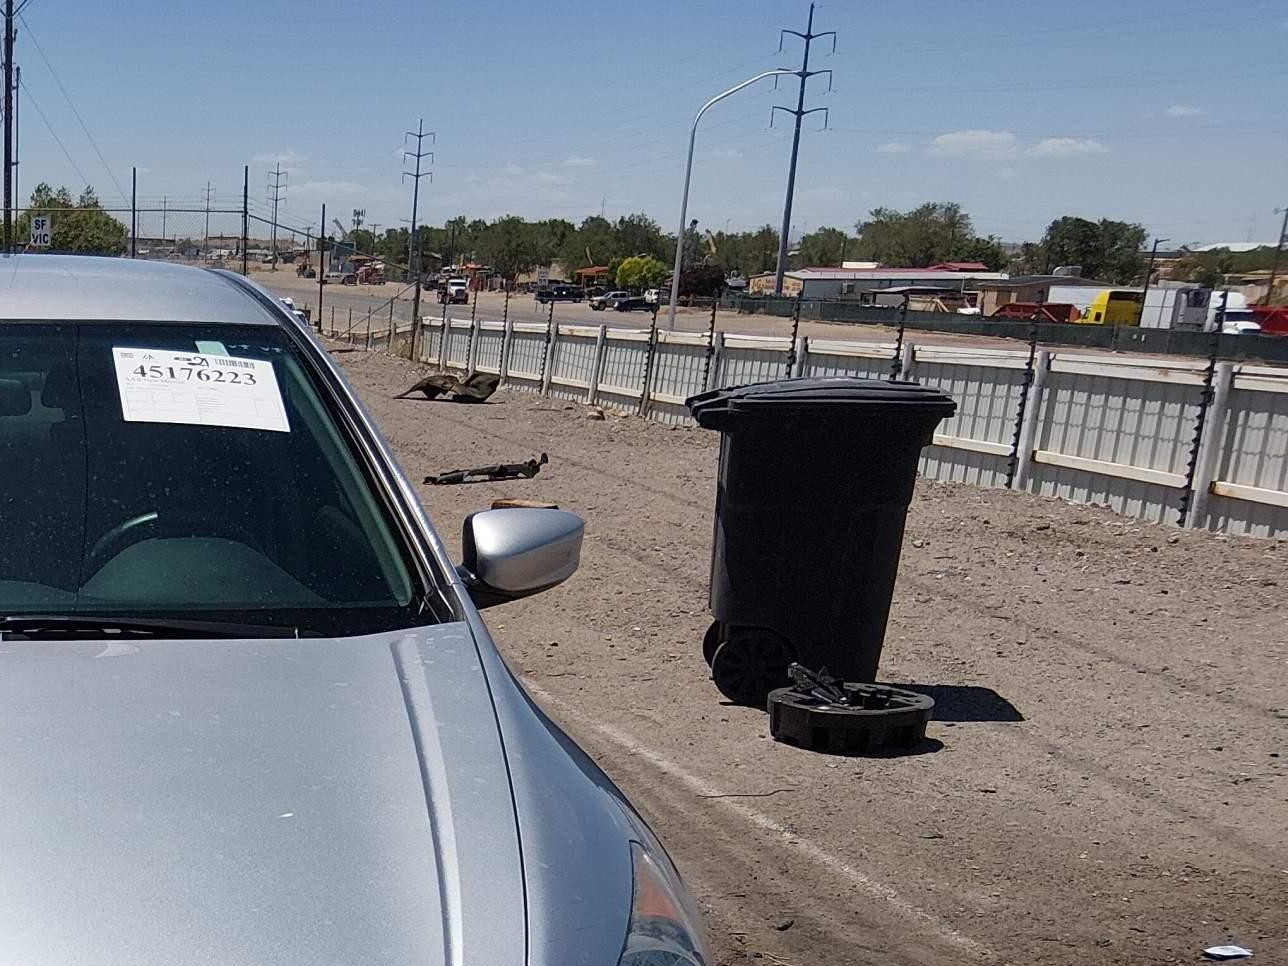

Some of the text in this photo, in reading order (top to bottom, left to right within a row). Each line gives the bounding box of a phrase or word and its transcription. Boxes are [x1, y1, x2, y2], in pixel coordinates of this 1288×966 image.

[34, 219, 47, 230] SF
[31, 233, 49, 244] VIC
[132, 364, 257, 386] 45176223
